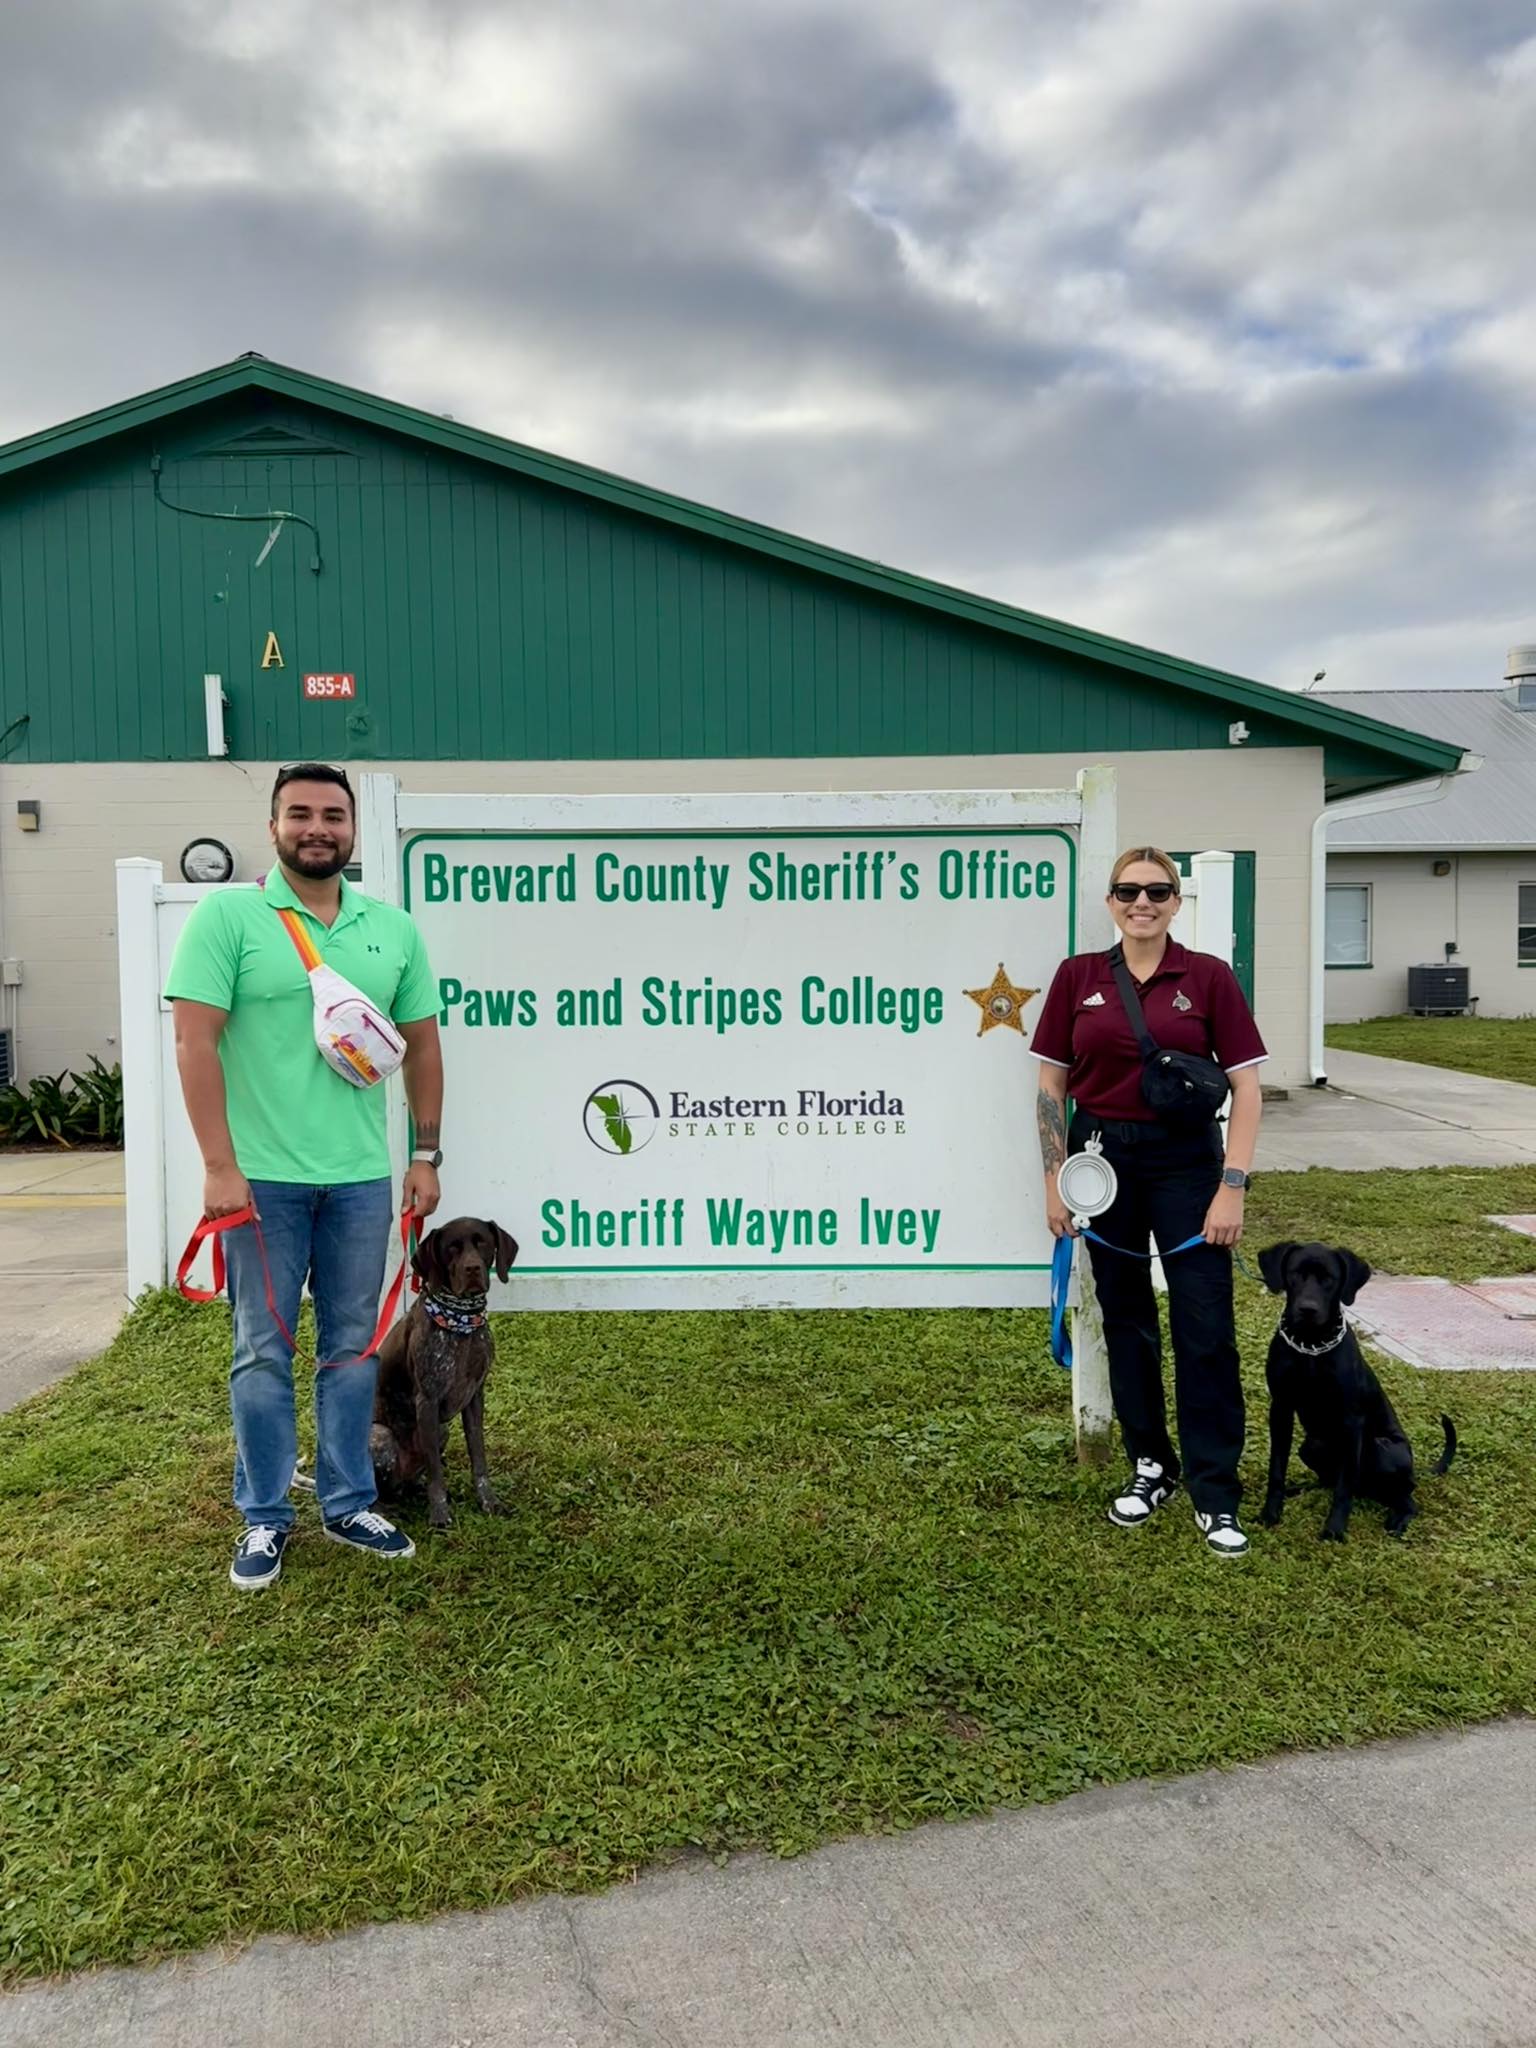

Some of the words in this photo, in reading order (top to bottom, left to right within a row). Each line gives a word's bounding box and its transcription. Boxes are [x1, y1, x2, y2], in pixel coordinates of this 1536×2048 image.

[261, 631, 285, 668] A
[307, 676, 351, 695] 855-A
[424, 853, 576, 902] Brevard
[596, 852, 729, 909] County
[749, 851, 919, 901] Sheriff's
[939, 849, 1055, 900] Office
[439, 978, 537, 1027] Paws
[557, 977, 622, 1027] and
[642, 977, 782, 1034] Stripes
[801, 976, 943, 1034] College
[669, 1092, 787, 1118] Eastern
[797, 1090, 904, 1116] Florida
[669, 1122, 756, 1137] STATE
[777, 1121, 907, 1136] COLLEGE
[541, 1198, 684, 1248] Sheriff
[706, 1198, 837, 1254] Wayne
[861, 1197, 941, 1253] Ivey
